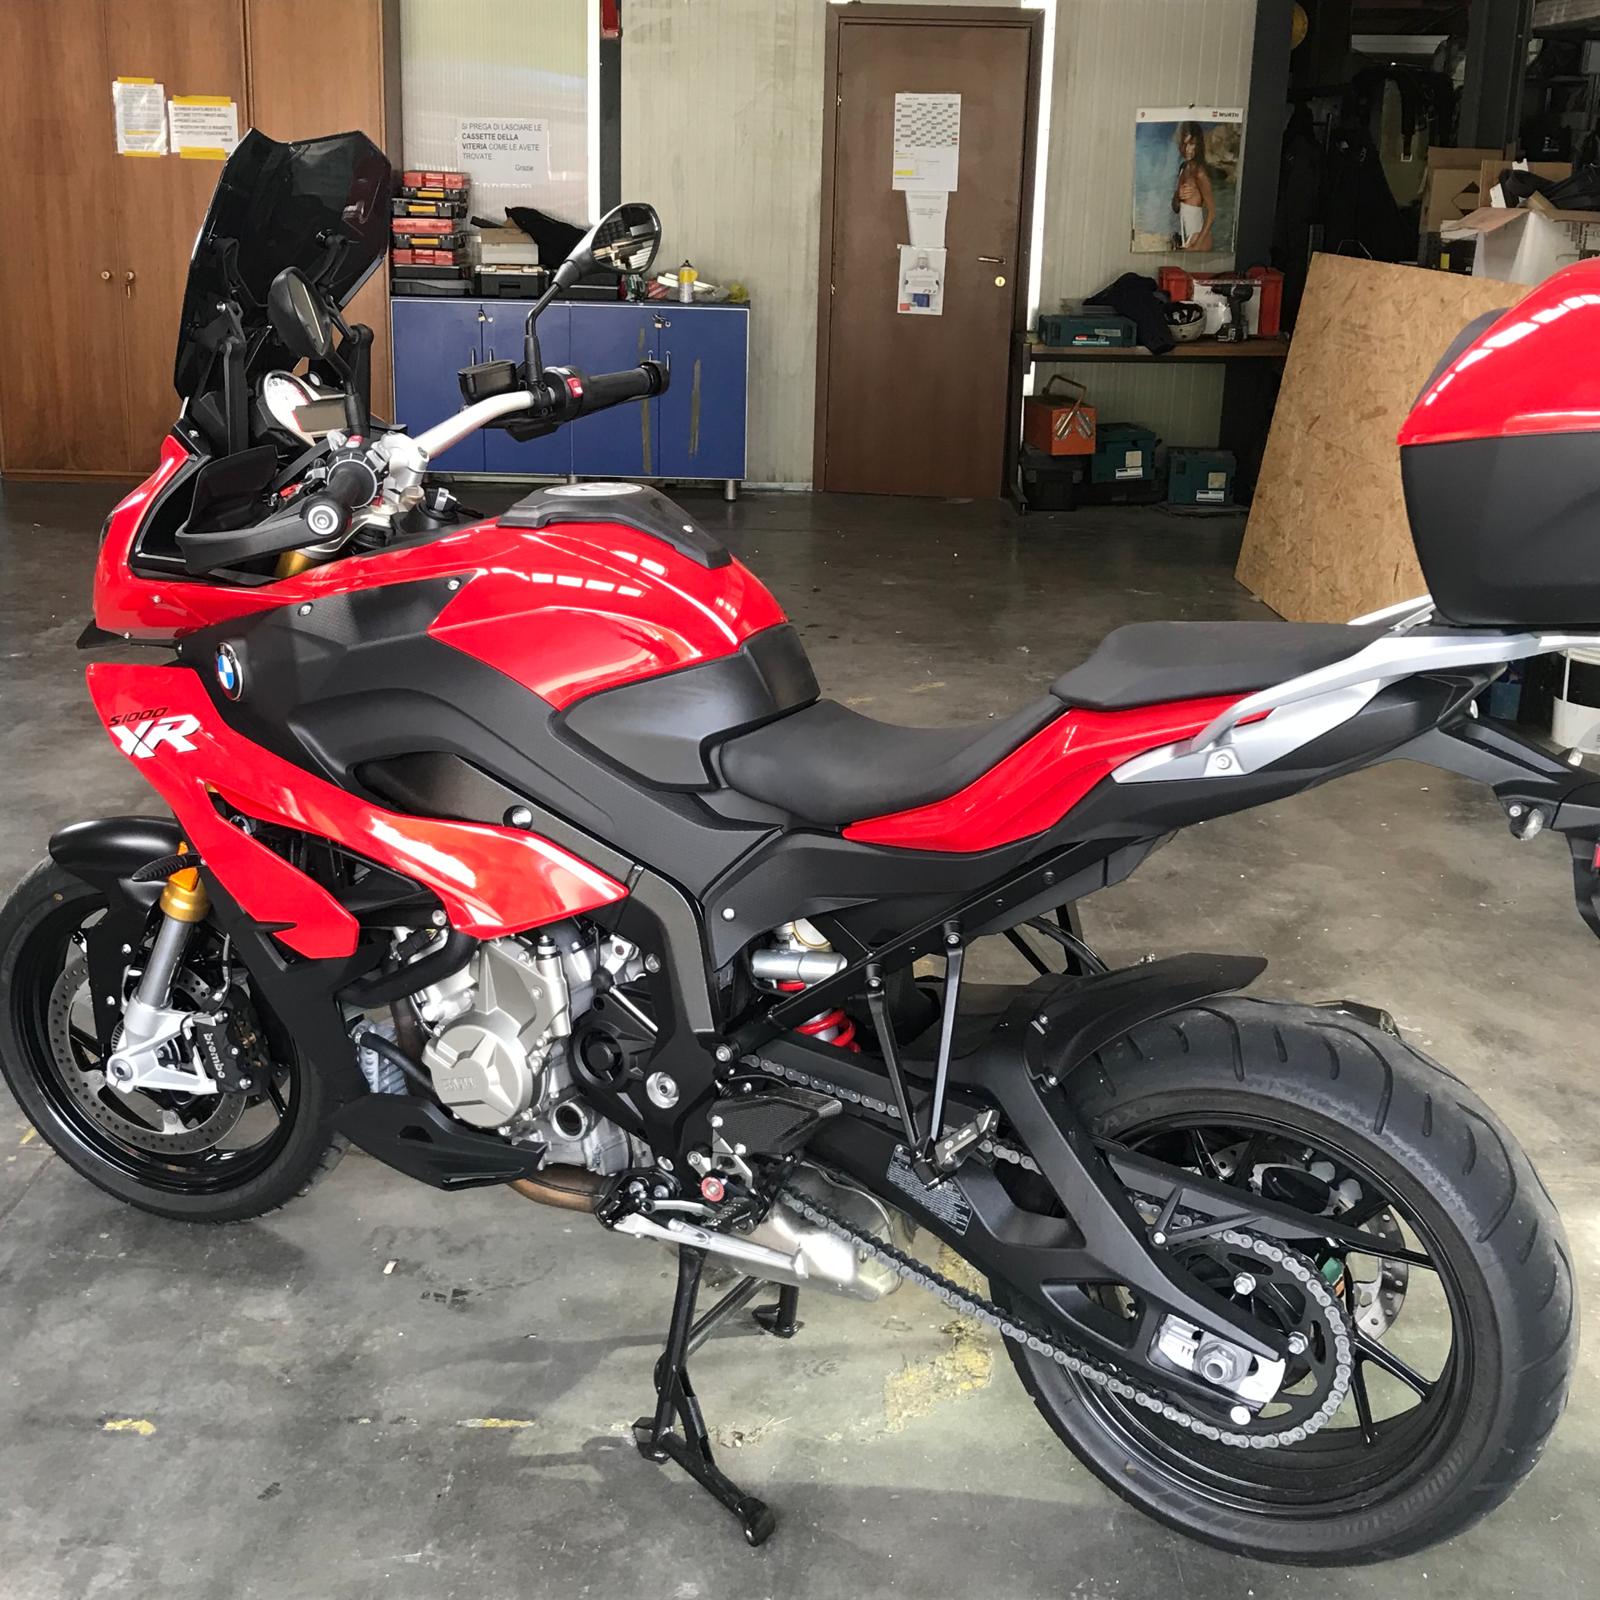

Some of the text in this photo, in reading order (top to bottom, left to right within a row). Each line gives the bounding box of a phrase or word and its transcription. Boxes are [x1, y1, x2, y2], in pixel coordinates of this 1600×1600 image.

[493, 123, 500, 131] DI
[501, 123, 533, 131] LASCIARE
[534, 124, 542, 132] LE
[461, 132, 519, 141] CASSETTE DELLA
[462, 143, 540, 152] VITERIA COME LE AVETE
[514, 164, 534, 172] Grazie
[109, 706, 168, 727] S1000
[109, 714, 201, 759] XR
[203, 1032, 226, 1078] brembo
